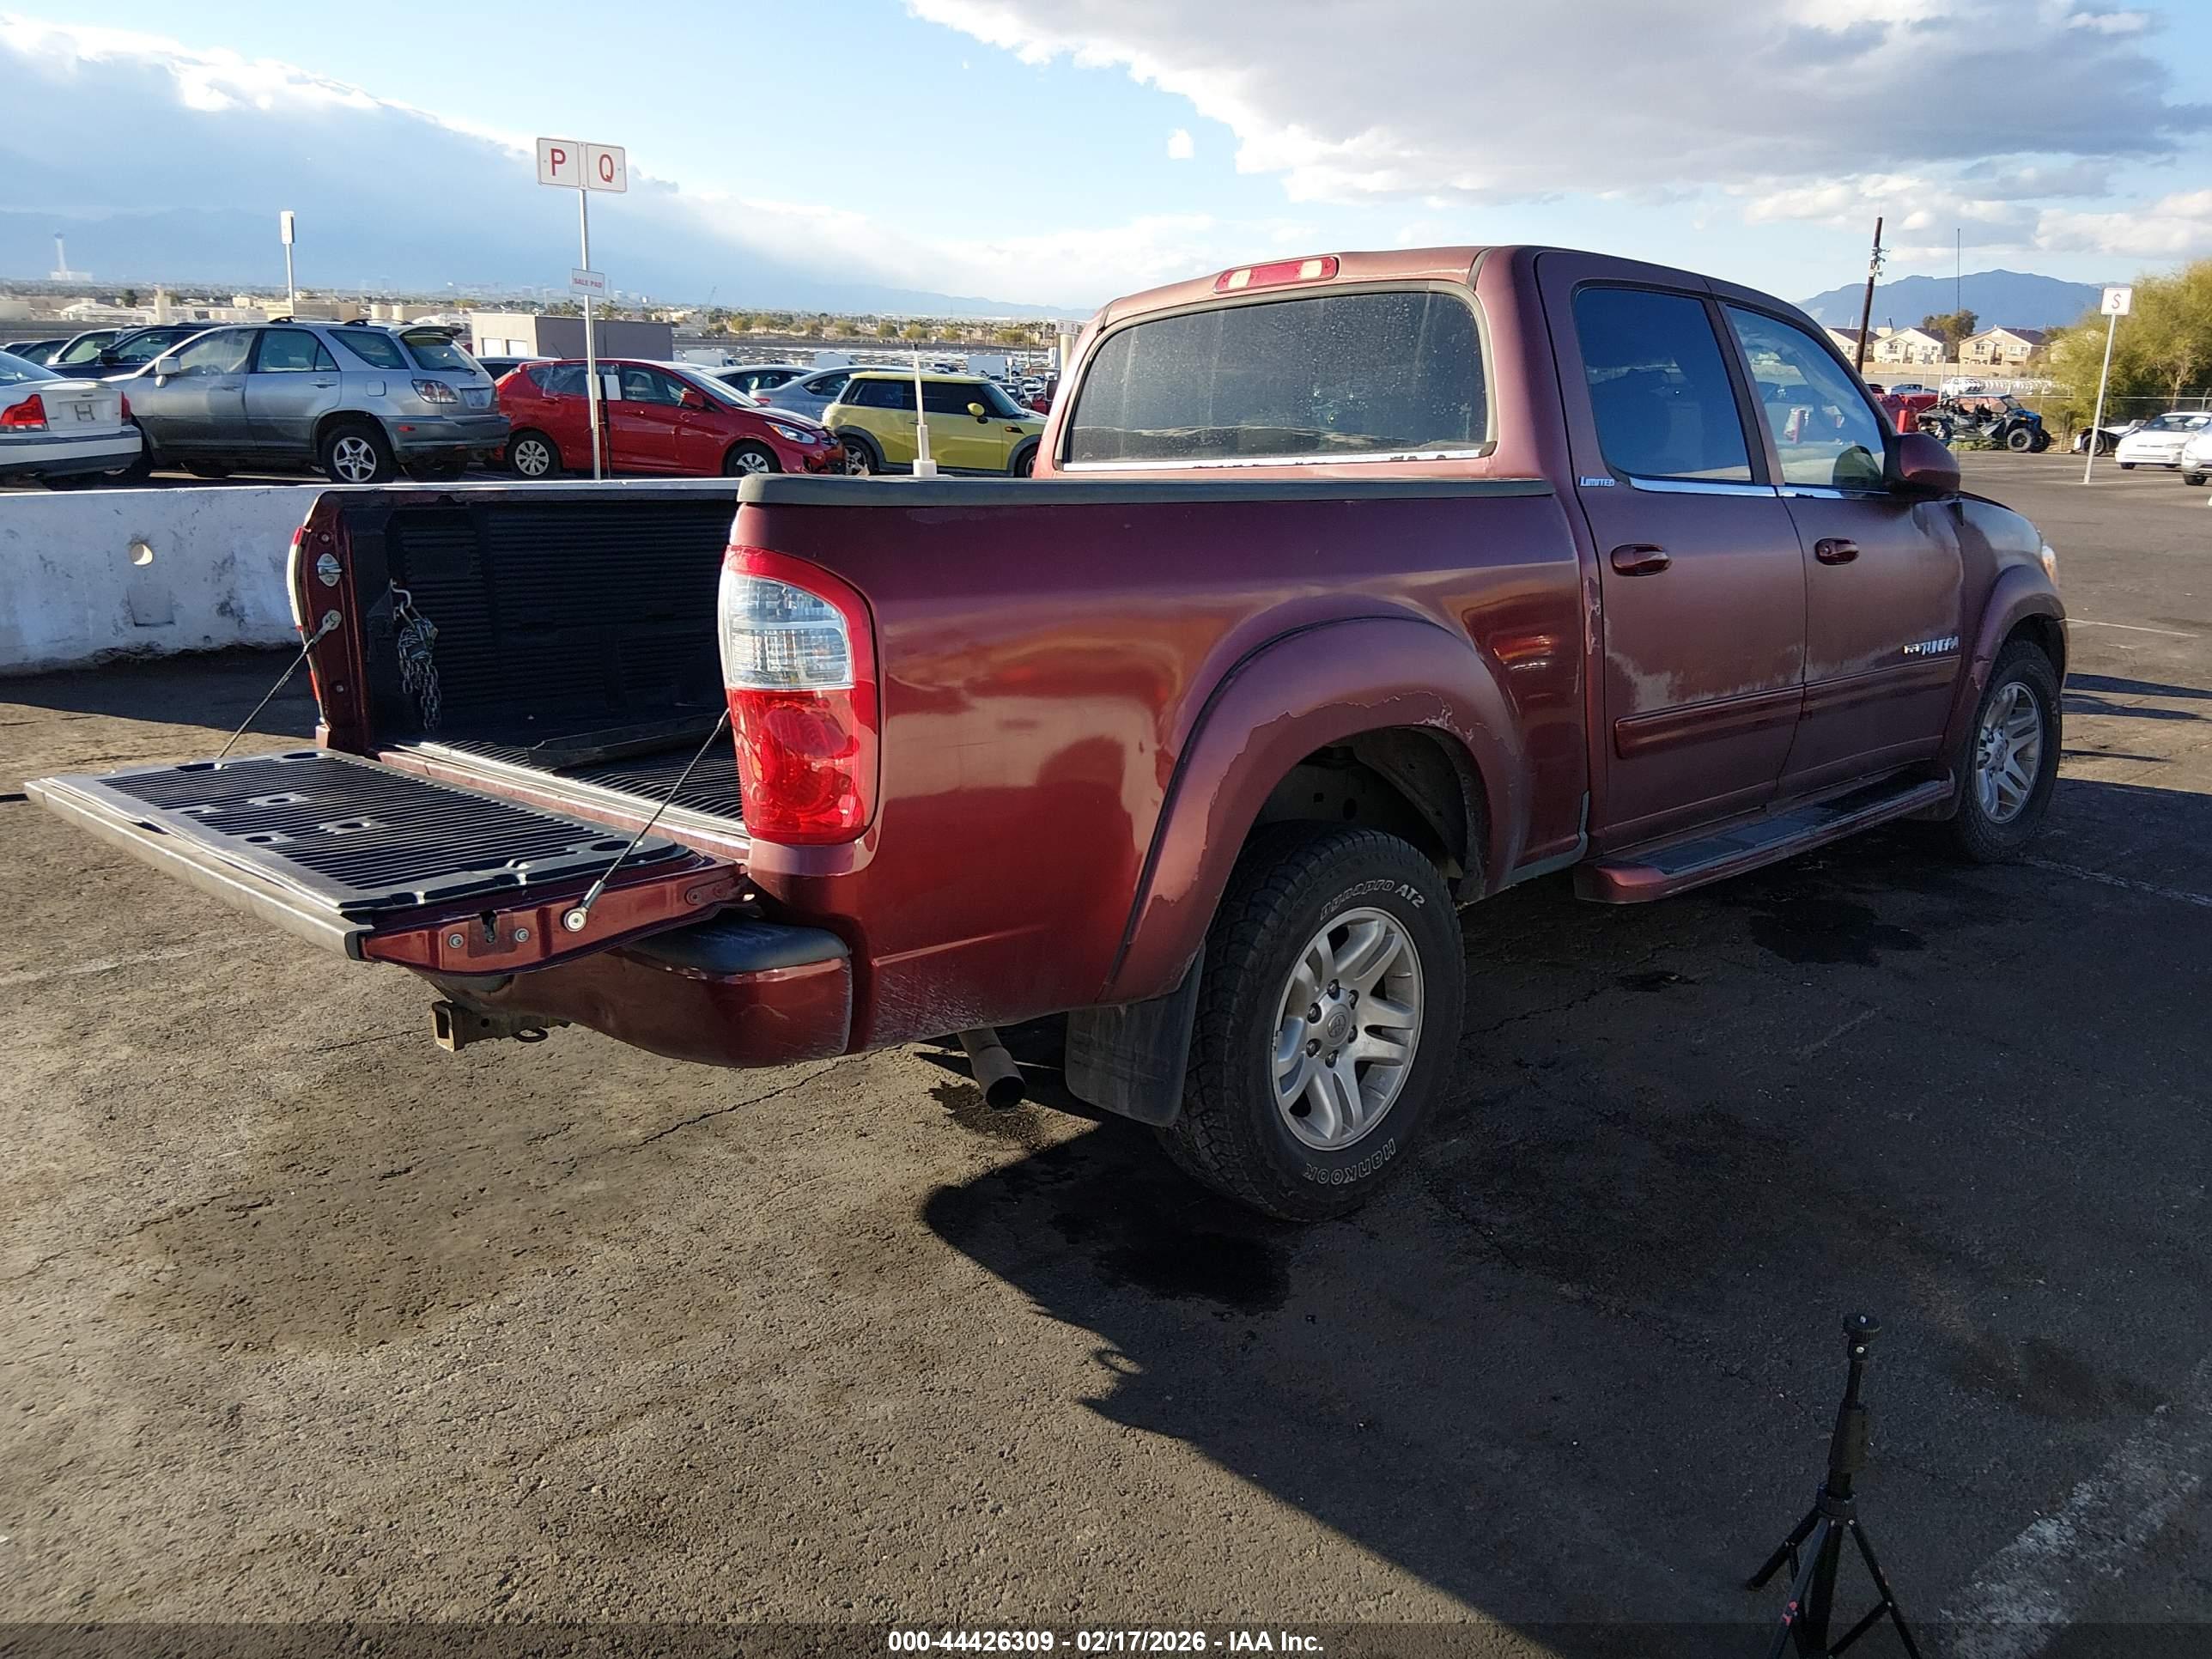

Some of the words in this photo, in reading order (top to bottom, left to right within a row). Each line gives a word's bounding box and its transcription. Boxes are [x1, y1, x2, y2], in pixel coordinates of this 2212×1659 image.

[550, 148, 567, 177] P
[599, 154, 615, 183] Q
[573, 277, 589, 287] SALE
[590, 280, 603, 289] PAD
[2112, 293, 2122, 309] S
[1060, 322, 1065, 331] R
[1071, 323, 1076, 333] S
[1395, 883, 1425, 909] AT2
